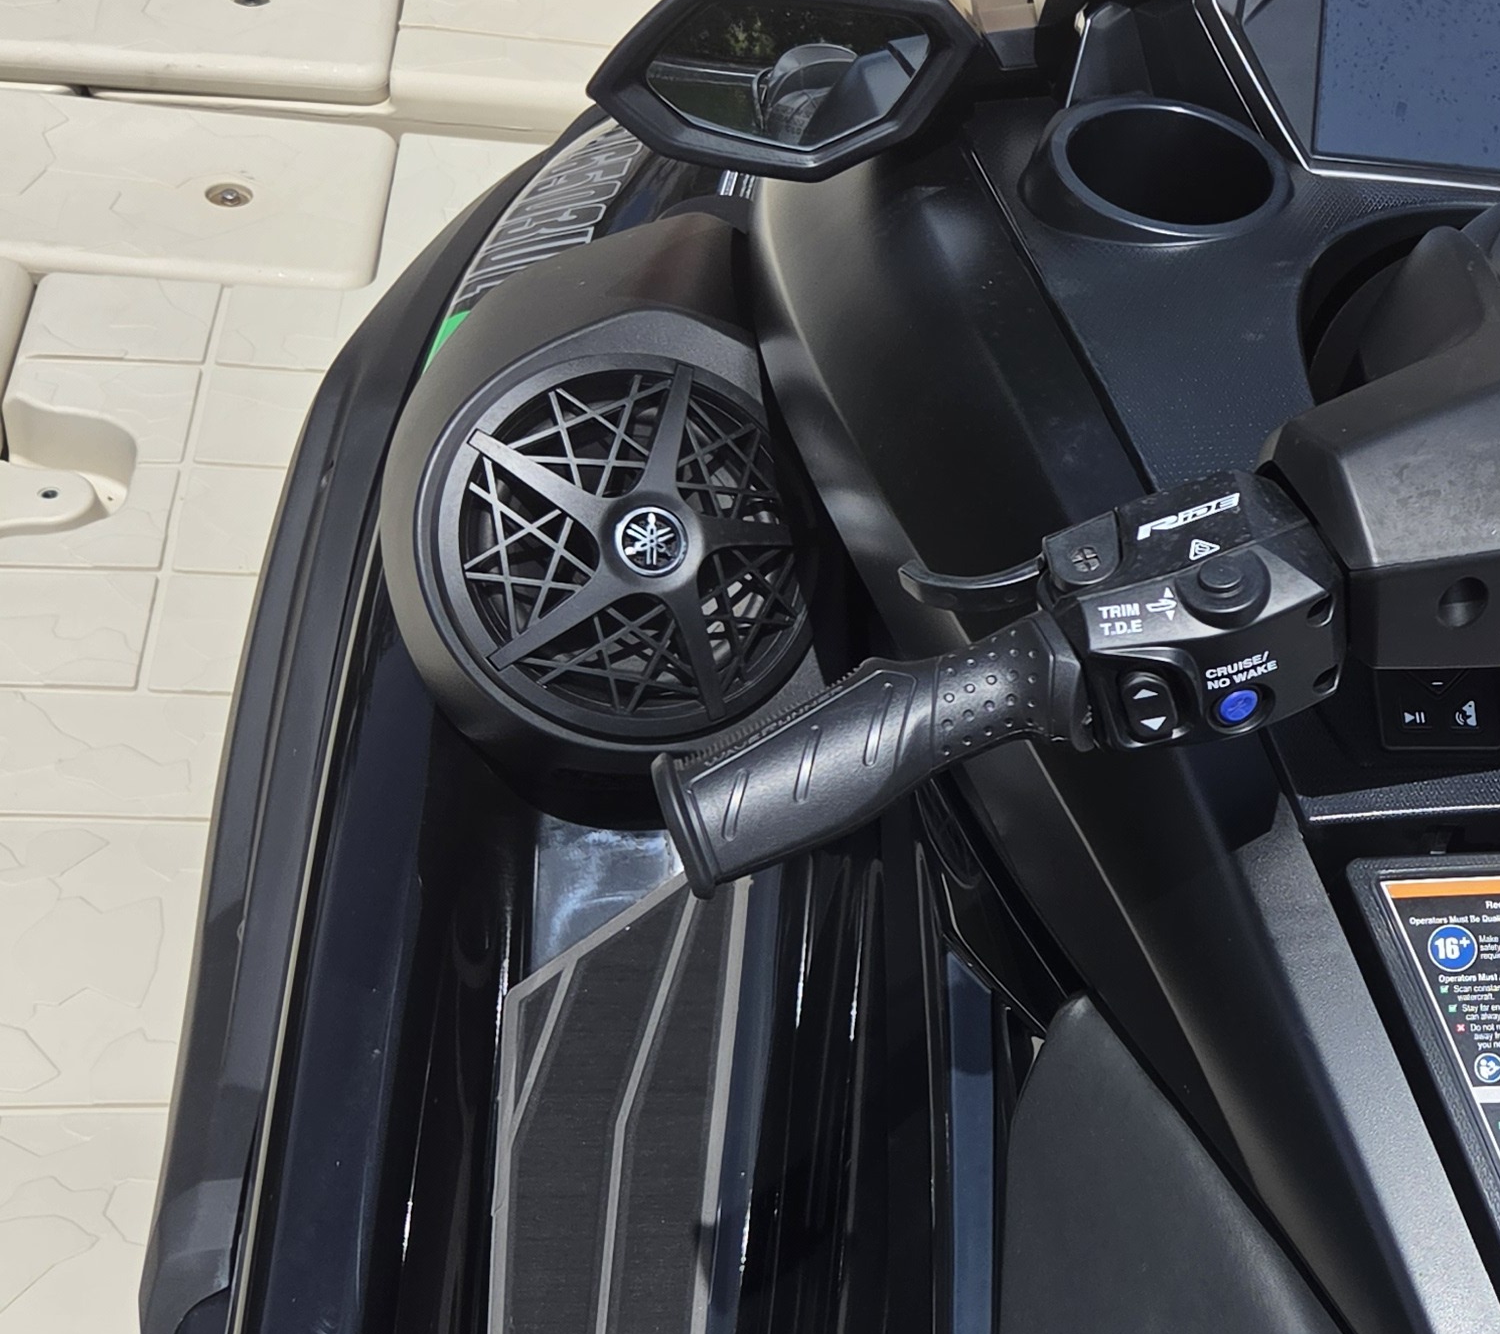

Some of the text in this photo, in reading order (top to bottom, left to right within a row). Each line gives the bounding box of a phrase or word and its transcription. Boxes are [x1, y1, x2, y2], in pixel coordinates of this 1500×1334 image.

[1098, 603, 1140, 619] TRIM
[1100, 620, 1143, 636] T.D.E
[1205, 650, 1270, 679] CRUISE/
[1207, 660, 1278, 691] NO WAKE
[1434, 936, 1471, 960] 16+
